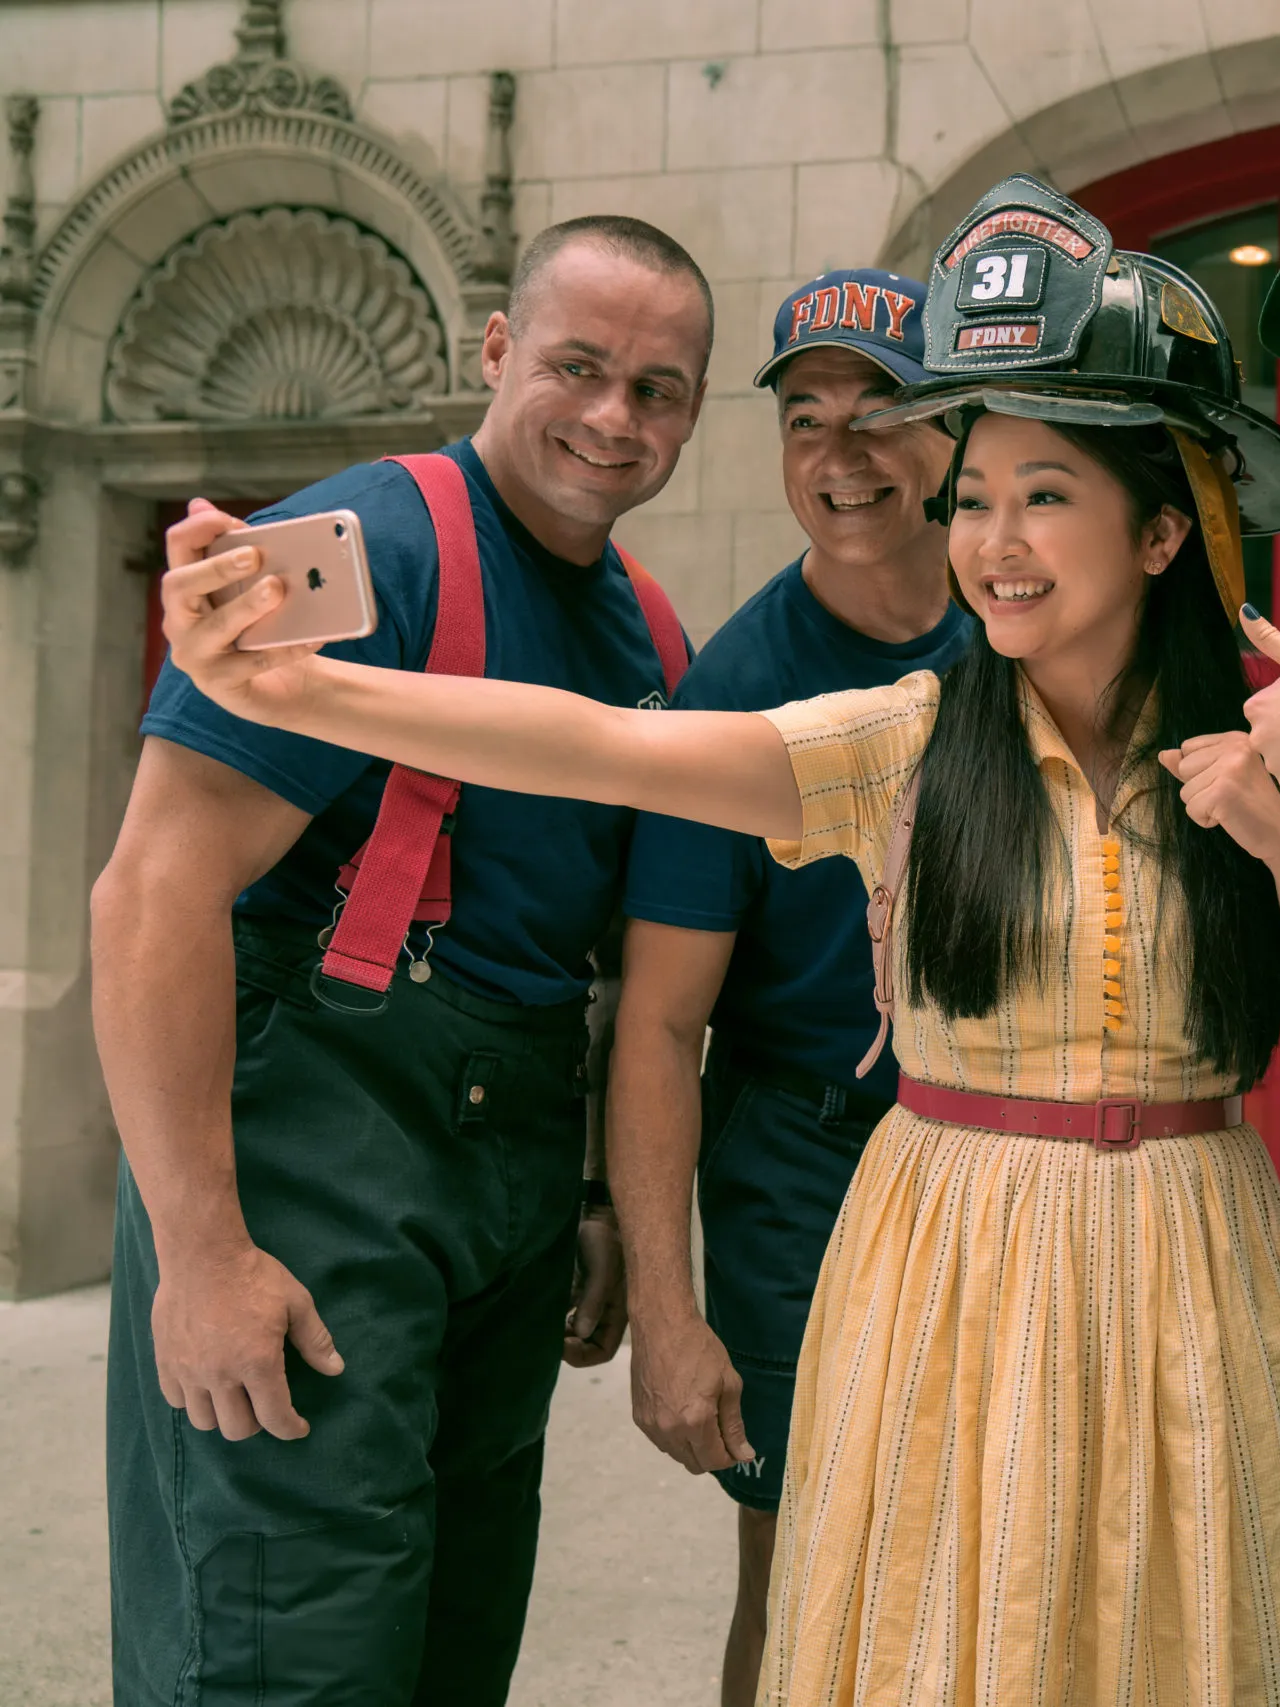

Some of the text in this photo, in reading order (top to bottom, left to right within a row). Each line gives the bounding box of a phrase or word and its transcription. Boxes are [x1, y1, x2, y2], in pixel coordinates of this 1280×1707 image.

[953, 213, 1083, 261] FIREFIGHTER
[971, 254, 1028, 300] 31
[788, 282, 915, 345] FDNY
[970, 326, 1026, 347] FDNY
